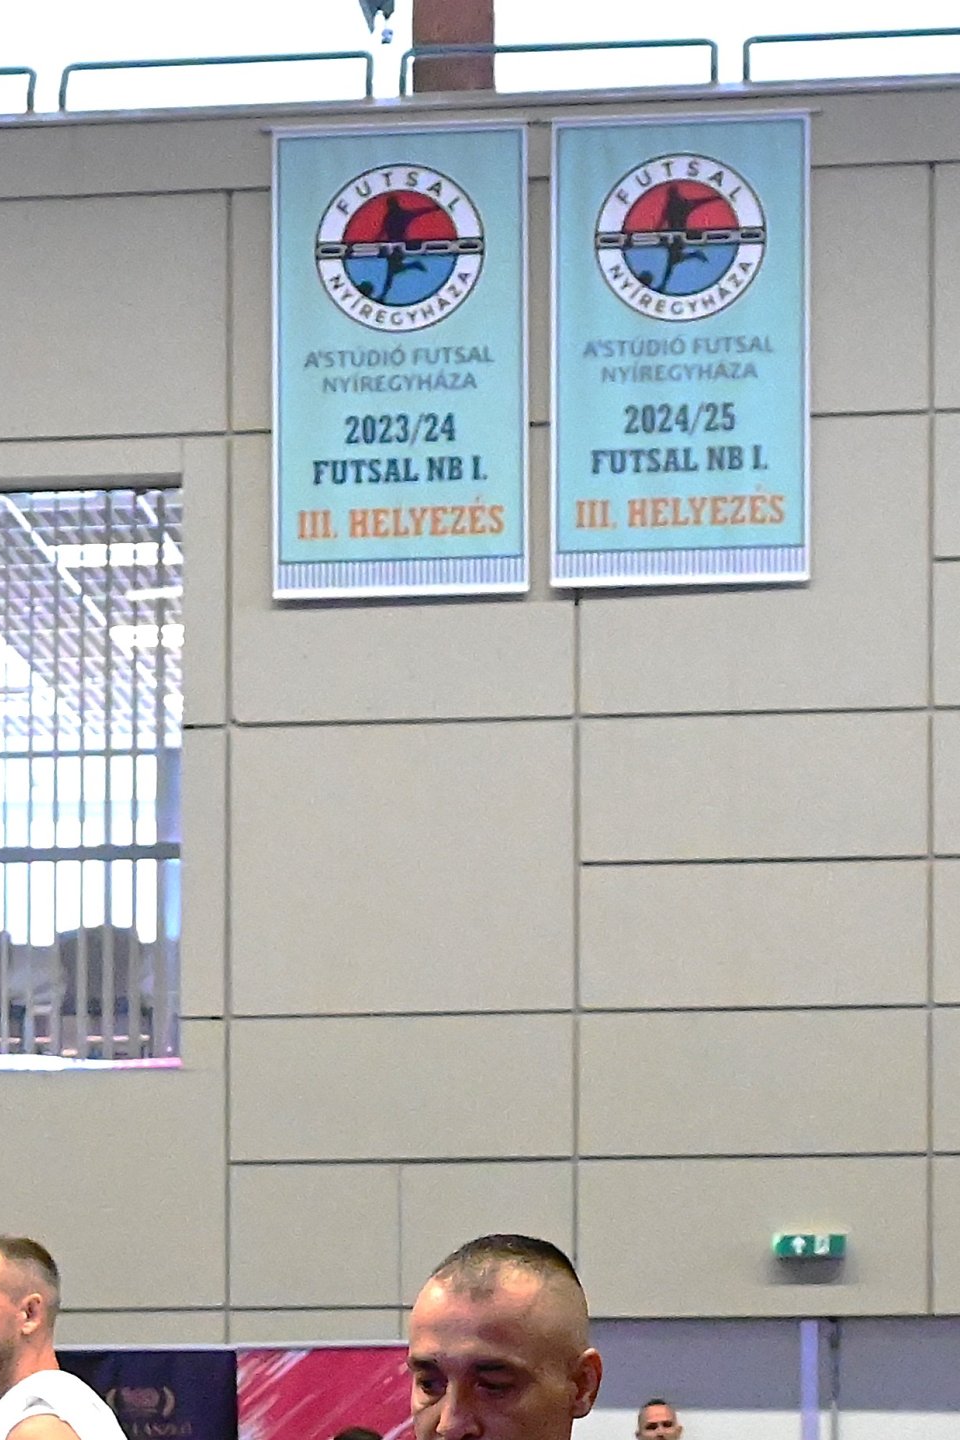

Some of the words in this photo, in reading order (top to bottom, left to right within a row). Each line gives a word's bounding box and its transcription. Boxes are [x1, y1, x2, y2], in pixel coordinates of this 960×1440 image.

[336, 171, 460, 215] FUTSAL
[616, 161, 741, 204] FUTSAL
[413, 346, 495, 365] FUTSAL
[693, 336, 774, 354] FUTSAL
[322, 368, 478, 393] NYÍREGYHÁZA
[601, 359, 758, 383] NYÍREGYHÁZA
[345, 412, 456, 446] 2023/24
[624, 402, 735, 436] 2024/25
[313, 457, 419, 485] FUTSAL
[427, 456, 463, 482] NB
[472, 455, 488, 481] I.
[592, 447, 699, 474] FUTSAL
[706, 446, 743, 471] NB
[752, 444, 768, 470] I.
[298, 509, 338, 540] III.
[348, 497, 505, 538] HELYEZÉS
[576, 499, 617, 529] III.
[628, 485, 785, 528] HELYEZÉS
